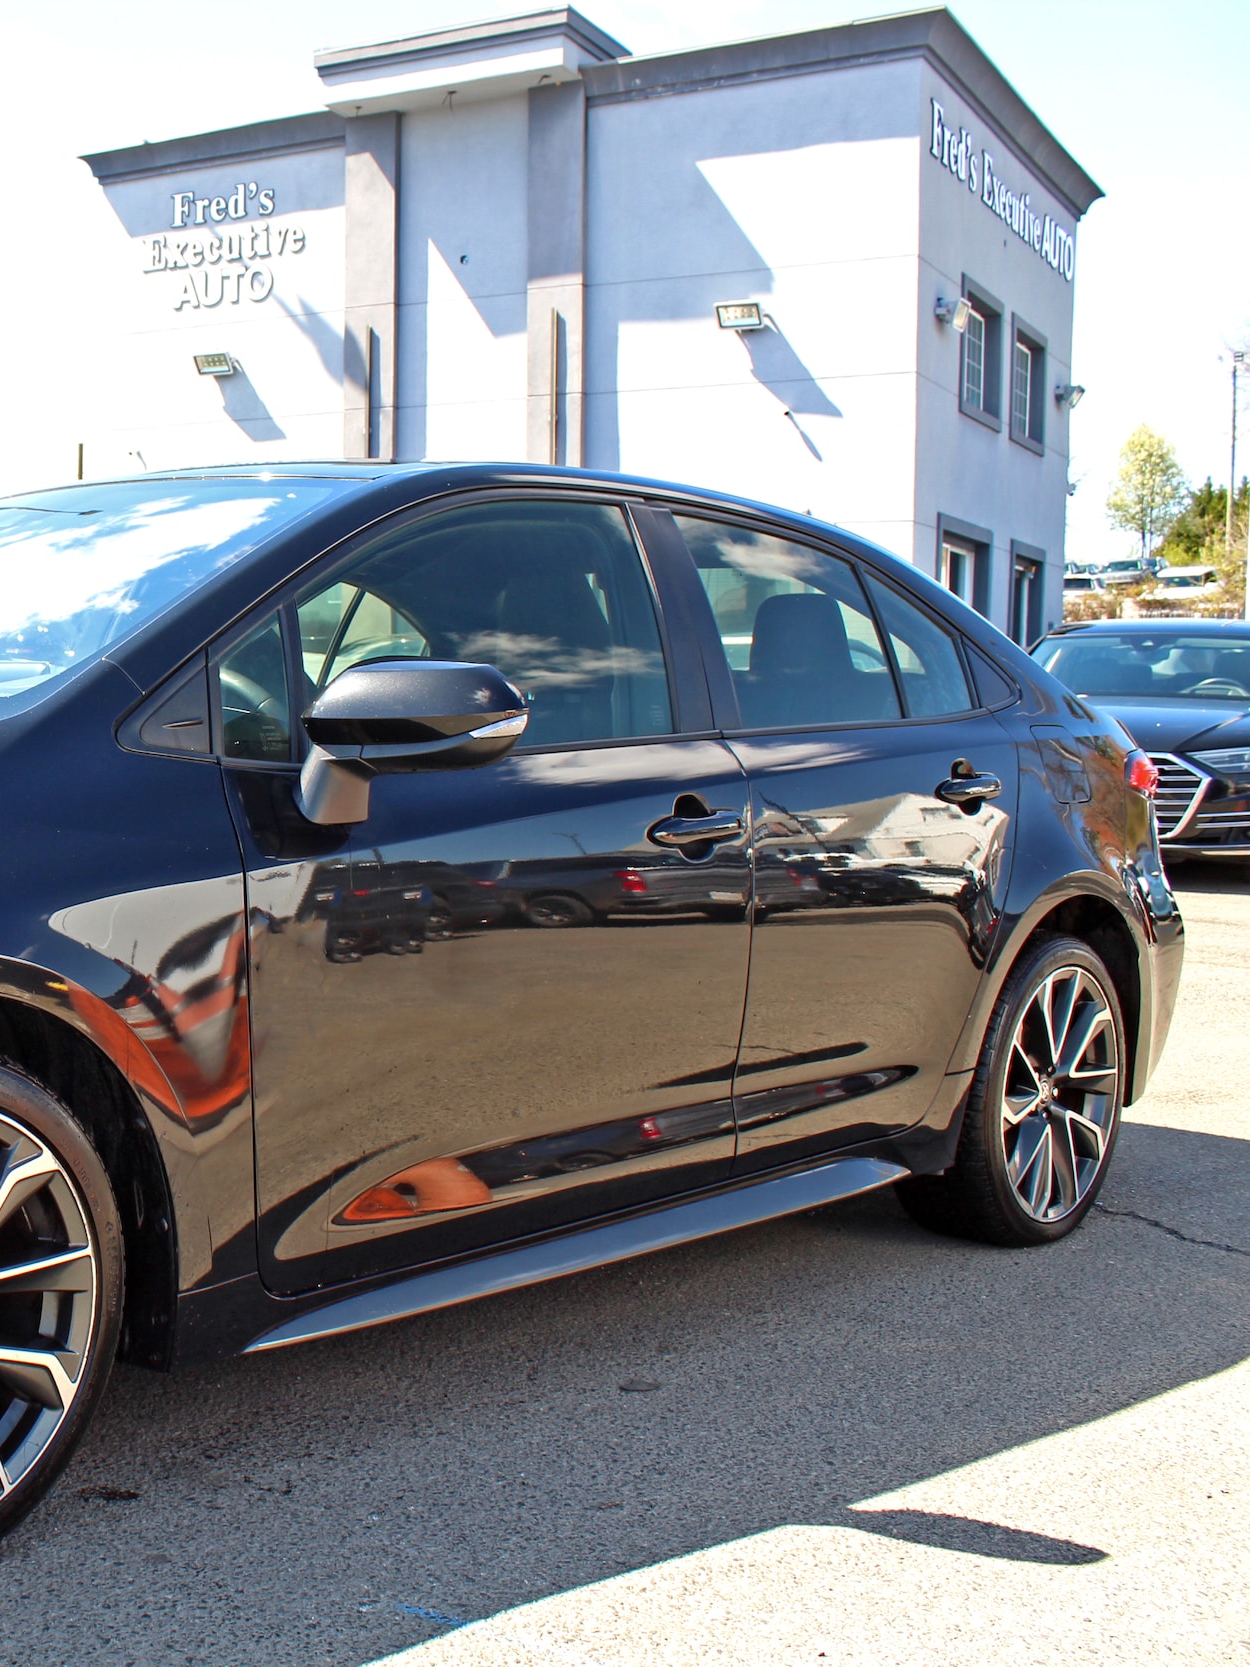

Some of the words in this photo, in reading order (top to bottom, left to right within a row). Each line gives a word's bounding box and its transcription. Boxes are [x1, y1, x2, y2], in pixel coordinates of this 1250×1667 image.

[170, 181, 276, 229] Fred's
[930, 97, 978, 193] Fred's
[981, 148, 1041, 253] Executive
[1040, 213, 1075, 282] AUTO
[141, 220, 307, 273] Executive
[172, 263, 274, 311] AUTO
